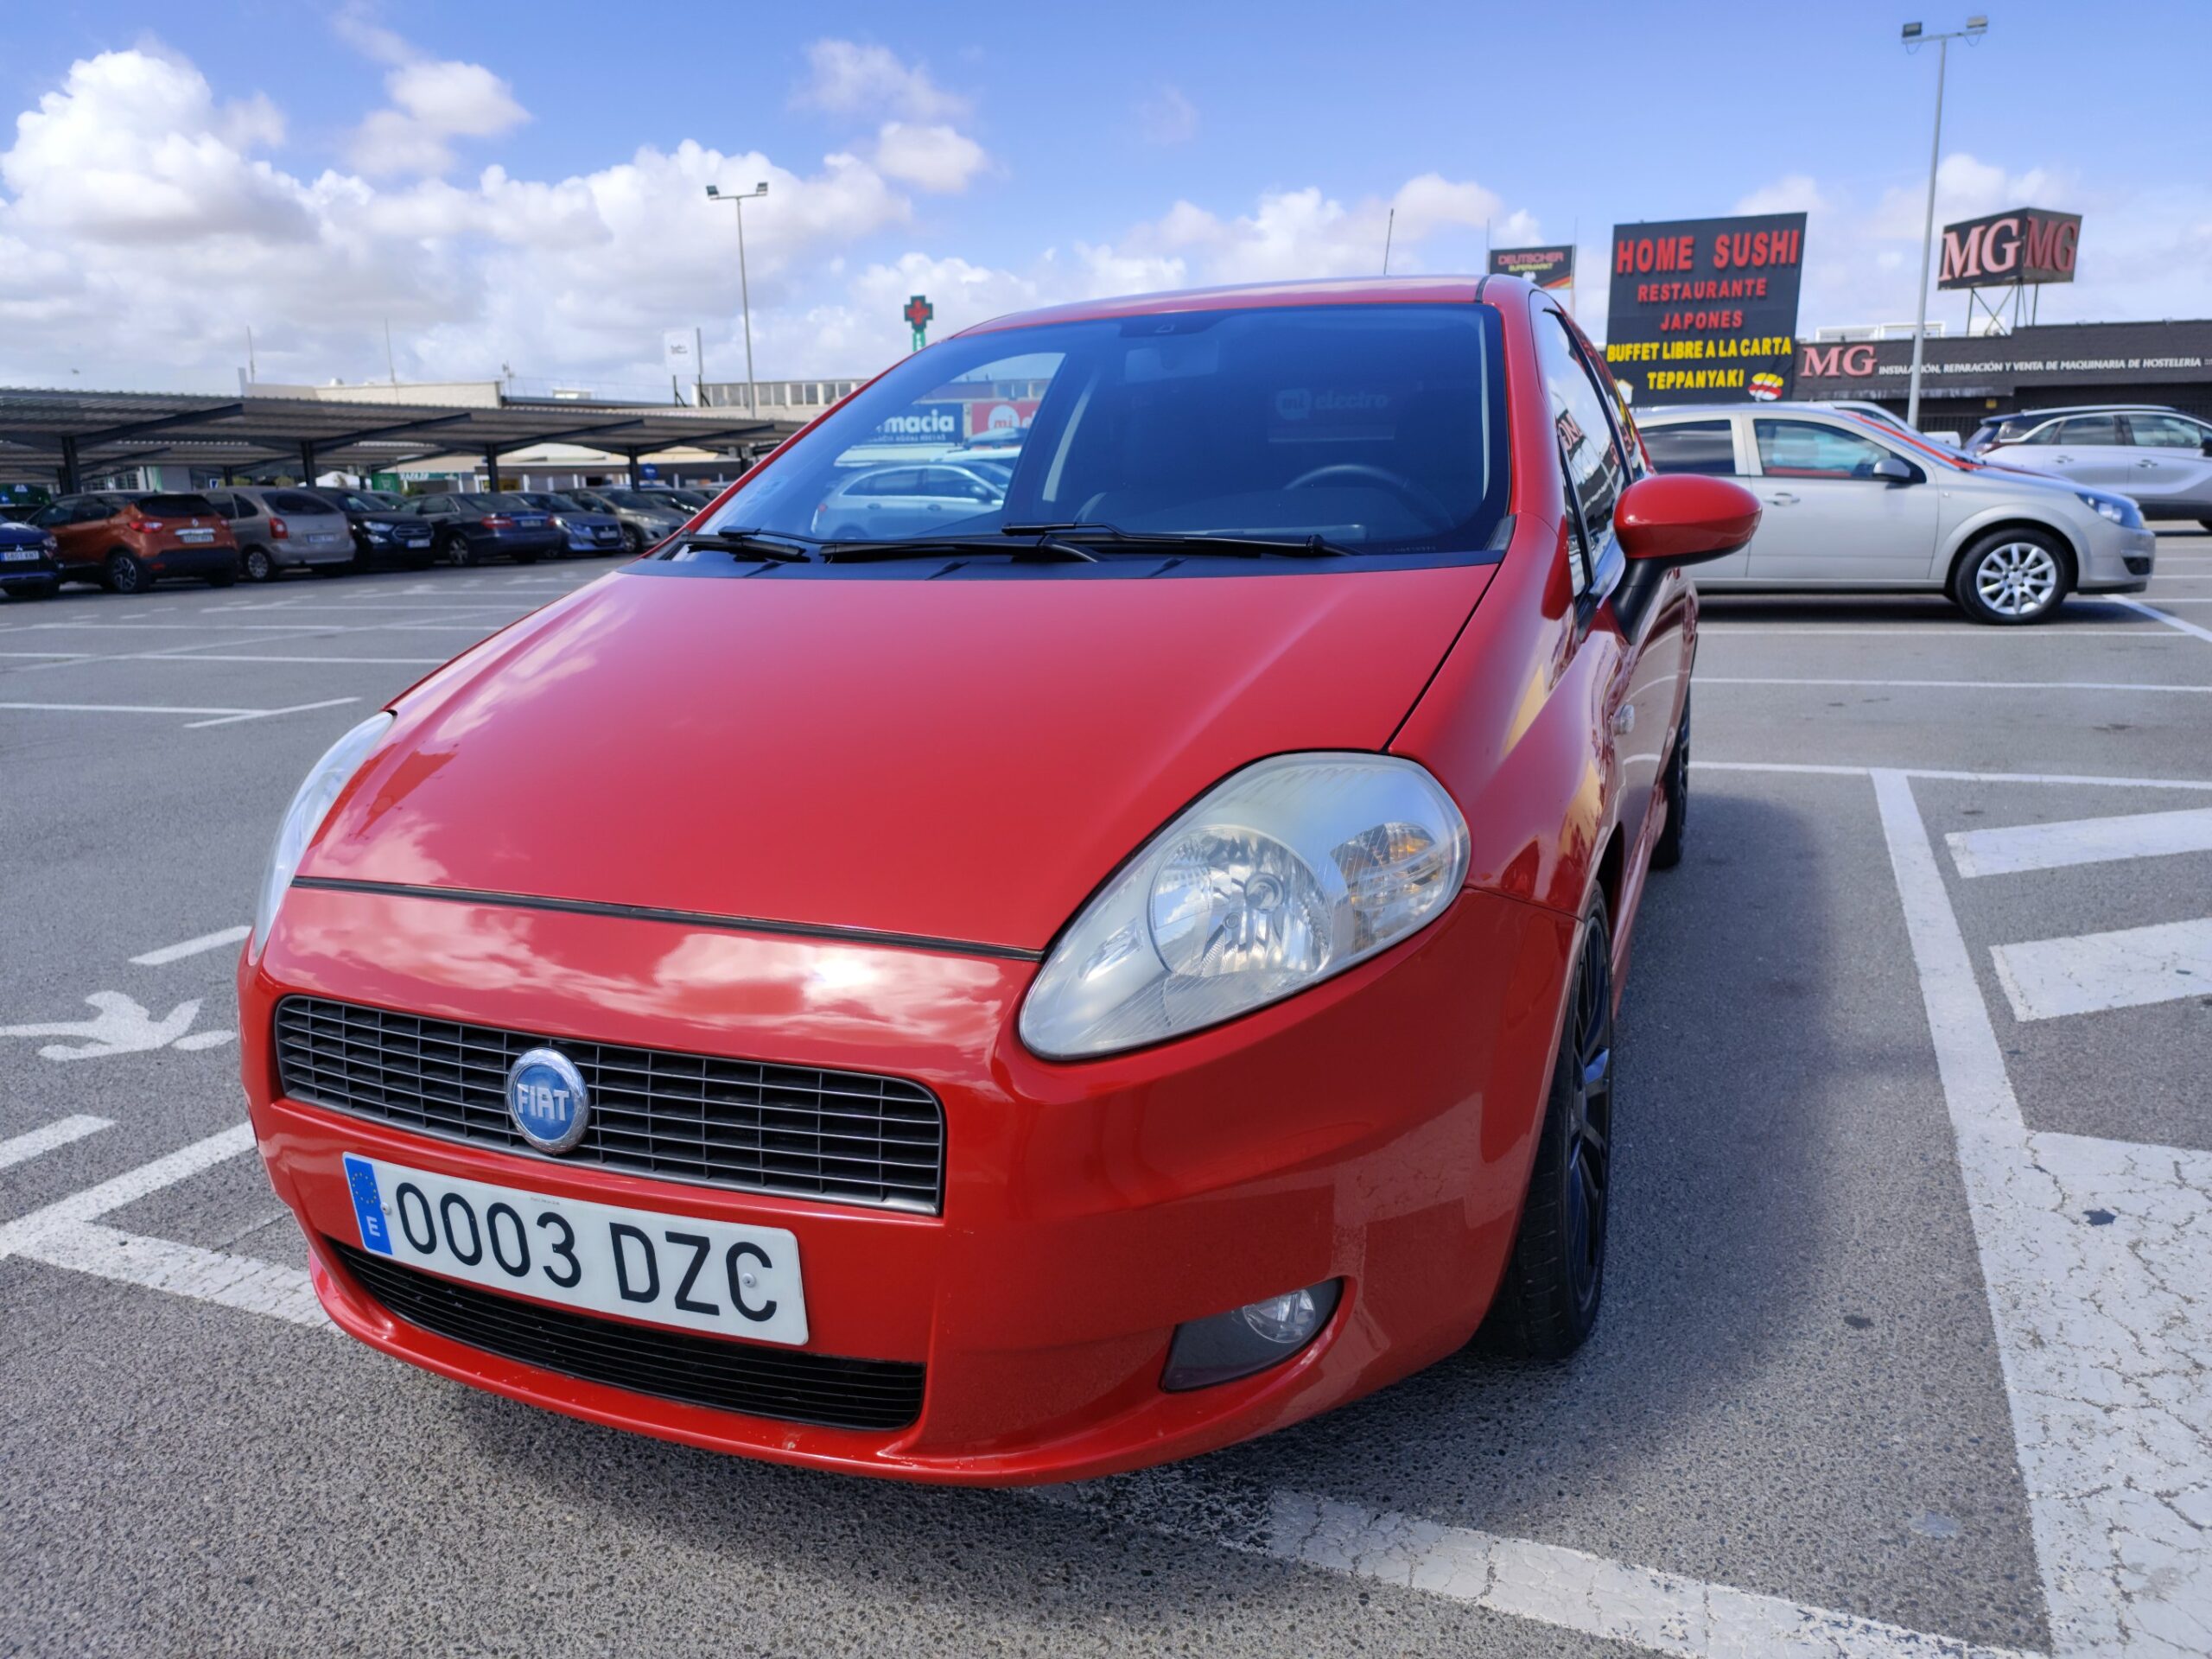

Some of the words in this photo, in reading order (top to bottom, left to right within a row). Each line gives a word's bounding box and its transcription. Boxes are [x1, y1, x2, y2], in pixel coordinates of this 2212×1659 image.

[1617, 236, 1694, 274] HOME
[1713, 230, 1799, 269] SUSHI
[1938, 218, 2021, 282] MG
[2024, 215, 2078, 272] MG
[1497, 251, 1564, 265] DEUTSCHER
[1637, 277, 1766, 302] RESTAURANTE
[1661, 310, 1743, 330] JAPONES
[1607, 343, 1659, 362] BUFFET
[1662, 340, 1702, 359] LIBRE
[1706, 340, 1716, 358] A
[1719, 339, 1738, 357] LA
[1740, 337, 1792, 356] CARTA
[1801, 346, 1878, 377] MG
[1878, 363, 1942, 375] INSTALAIÓN,
[1943, 360, 2003, 373] REPARACIÓN
[2005, 361, 2012, 372] Y
[2012, 360, 2044, 372] VENTA
[2045, 360, 2058, 371] DE
[2060, 359, 2126, 370] MAQUINARIA
[2127, 359, 2140, 368] DE
[2143, 358, 2202, 368] HOSTELERIA
[1647, 370, 1744, 390] TEPPANYAKI
[518, 1084, 570, 1121] FIAT
[366, 1216, 381, 1237] E
[396, 1182, 582, 1289] 0003
[609, 1222, 778, 1322] DZC
